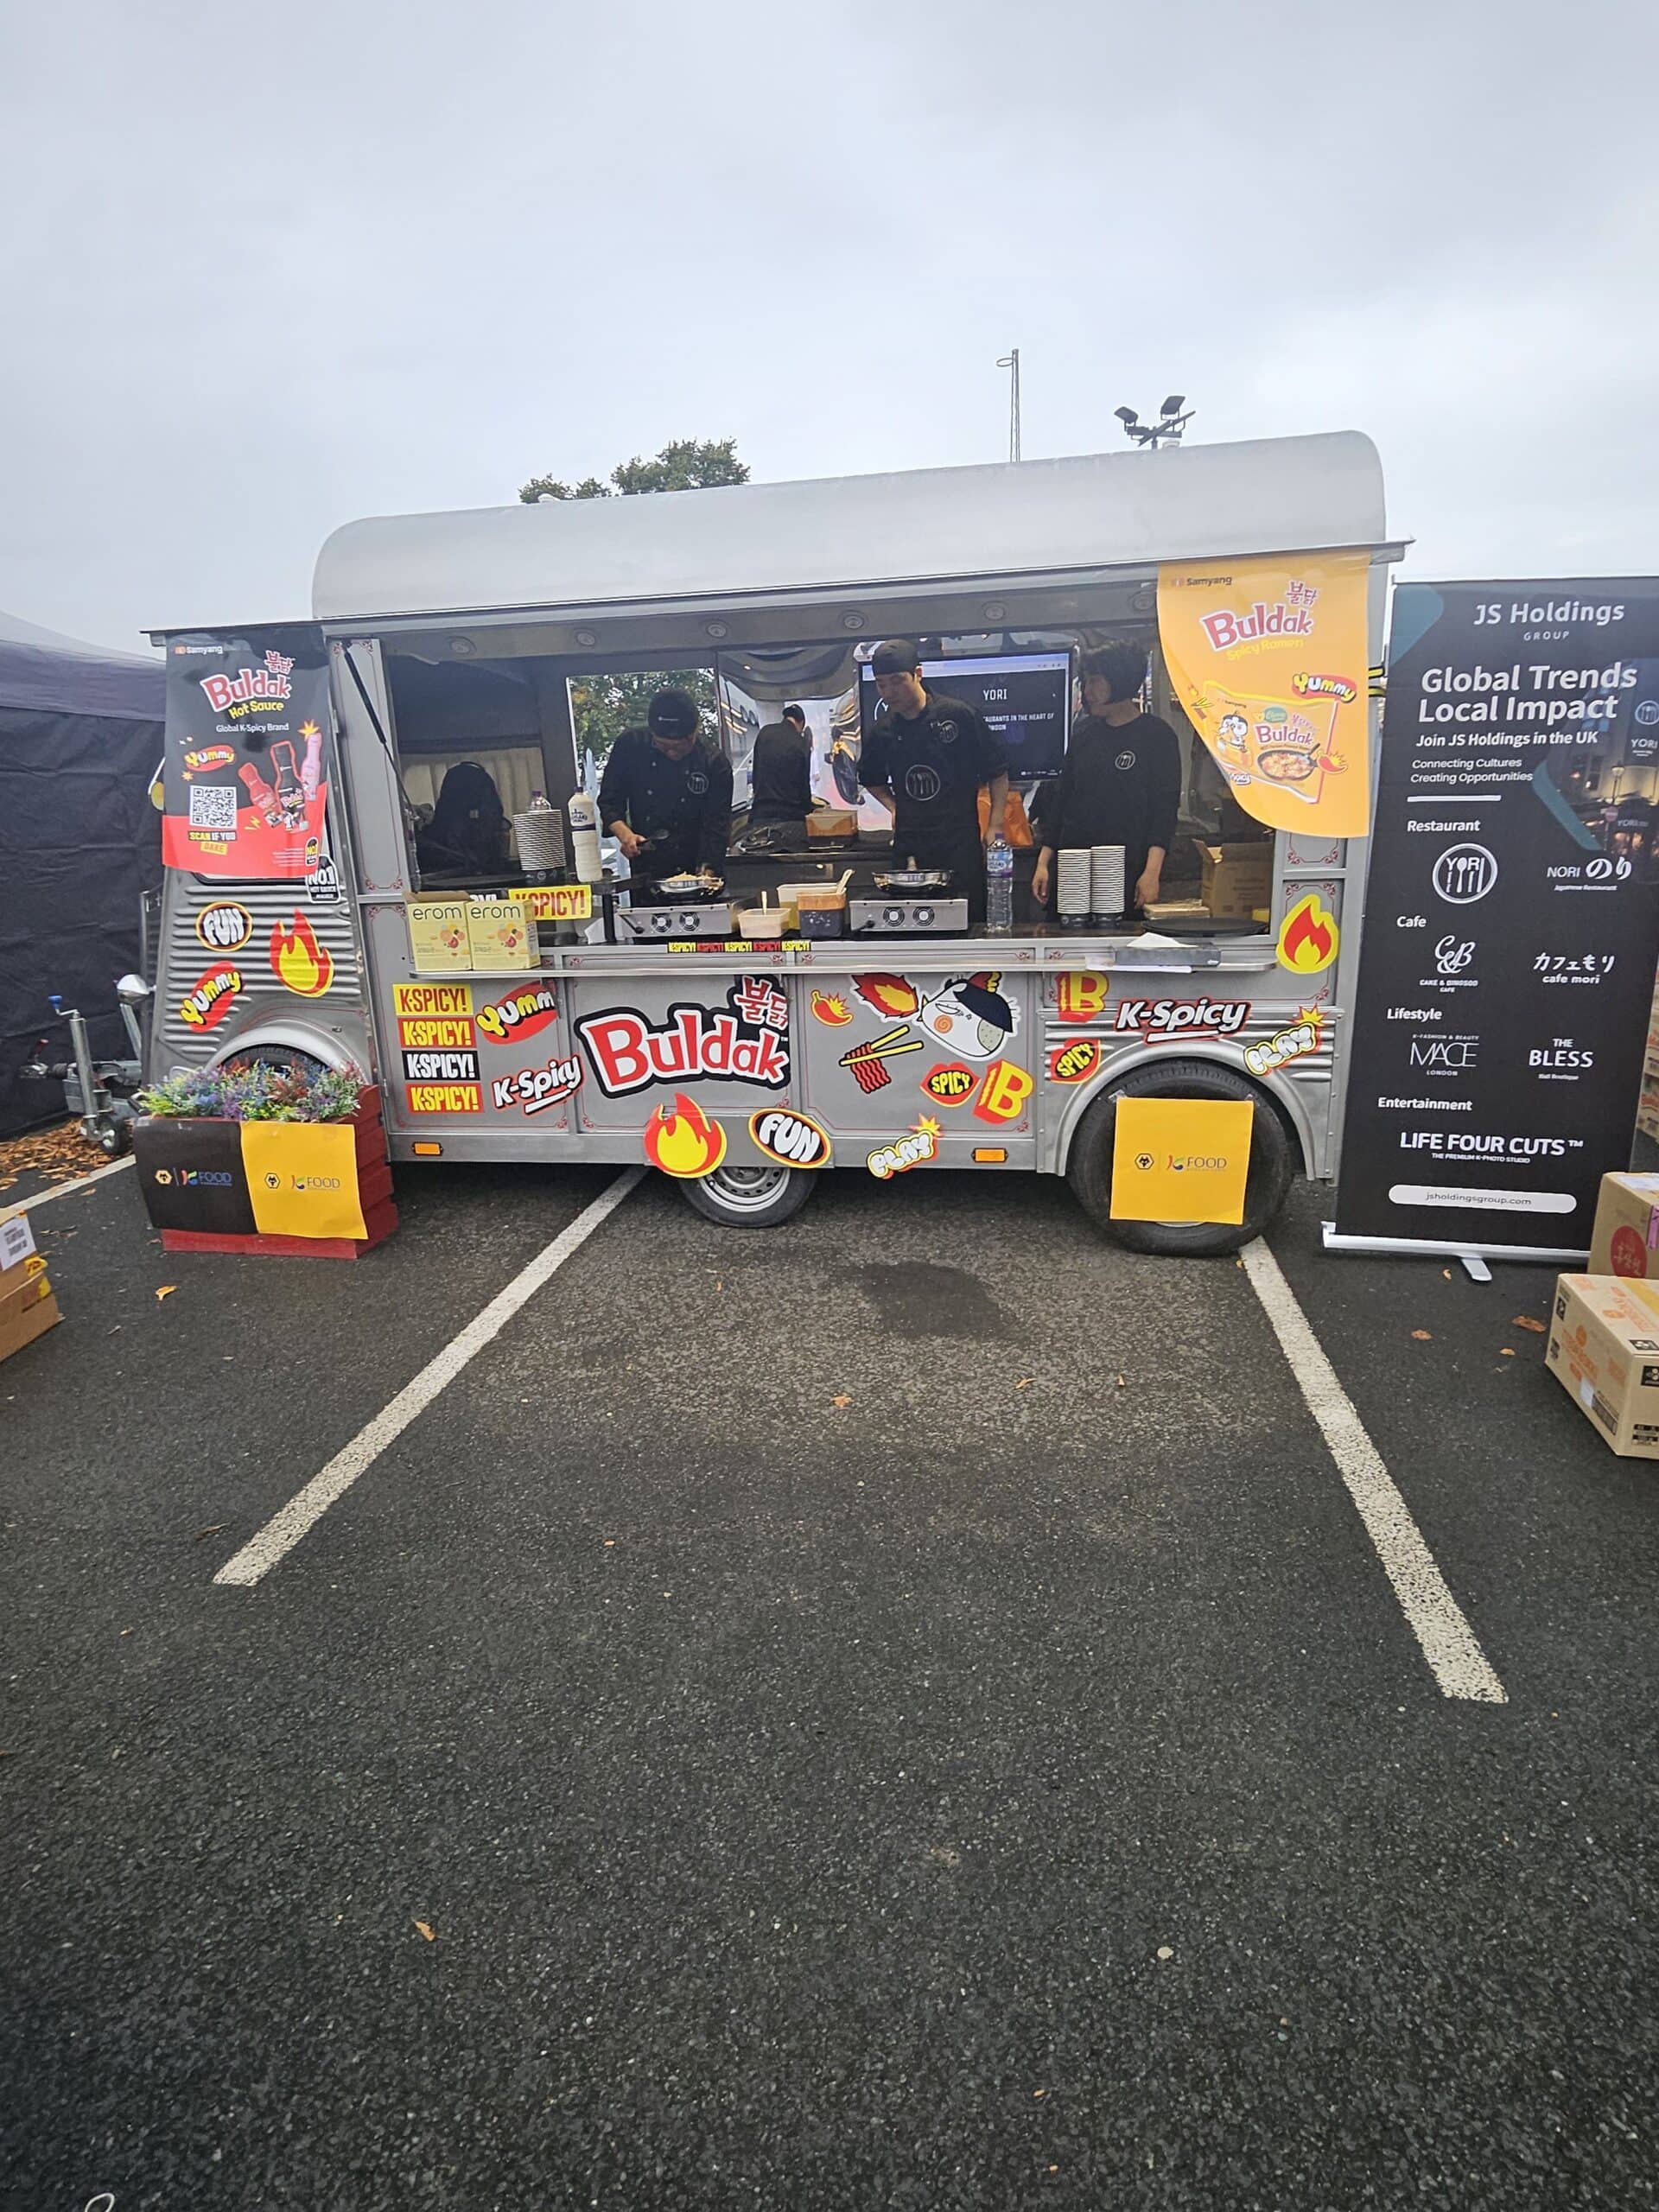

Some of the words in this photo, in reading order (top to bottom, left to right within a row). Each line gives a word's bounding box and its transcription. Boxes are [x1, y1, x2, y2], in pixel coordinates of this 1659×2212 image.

[1186, 575, 1232, 586] Samyang
[1286, 581, 1317, 605] 불닭
[1474, 604, 1502, 626] JS
[1510, 601, 1624, 626] Holdings
[1199, 602, 1313, 651] Buldak
[1523, 631, 1570, 641] GROUP
[1262, 638, 1304, 652] Ramen
[1421, 664, 1520, 692] Global
[1529, 662, 1637, 690] Trends
[200, 669, 292, 712] Buldak
[982, 689, 1007, 701] YORI
[229, 704, 250, 719] Hot
[250, 701, 284, 713] Sauce
[1419, 696, 1498, 722] Local
[1506, 695, 1618, 726] Impact
[216, 725, 238, 734] Global
[240, 724, 266, 734] K-Spicy
[267, 723, 289, 732] Brand
[1255, 724, 1313, 746] Buldak
[1416, 734, 1446, 747] Join
[1448, 734, 1465, 747] JS
[1468, 733, 1530, 748] Holdings
[1533, 732, 1546, 745] in
[1548, 732, 1573, 744] the
[1575, 731, 1599, 744] UK
[1412, 759, 1474, 771] Connecting
[1476, 758, 1522, 768] Cultures
[1411, 772, 1457, 785] Creating
[1459, 771, 1533, 784] Opportunities
[1407, 820, 1481, 832] Restaurant
[189, 832, 211, 841] SCAN
[1547, 866, 1581, 878] NORI
[1586, 856, 1632, 880] のり
[413, 906, 461, 920] erom
[471, 906, 520, 919] erom
[204, 907, 245, 945] FUN
[1396, 915, 1427, 928] Cafe
[1533, 951, 1615, 973] カフェもり
[1542, 974, 1567, 984] cafe
[1571, 974, 1600, 984] mori
[1117, 997, 1247, 1034] K-Spicy
[1387, 1007, 1442, 1022] Lifestyle
[580, 1010, 789, 1092] Buldak
[1553, 1038, 1573, 1048] THE
[1057, 1042, 1095, 1077] SPICY
[1409, 1041, 1480, 1067] MACE
[1529, 1049, 1593, 1068] BLESS
[493, 1056, 582, 1108] K-Spicy
[931, 1071, 970, 1094] SPICY
[1378, 1096, 1472, 1111] Entertainment
[759, 1113, 821, 1163] FUN
[1400, 1132, 1443, 1150] LIFE
[1447, 1134, 1504, 1154] FOUR
[1510, 1137, 1565, 1156] CUTS
[1187, 1156, 1227, 1169] FOOD
[198, 1172, 232, 1183] FOOD
[307, 1176, 340, 1188] FOOD
[1426, 1192, 1532, 1205] jsholdingsgroup.com
